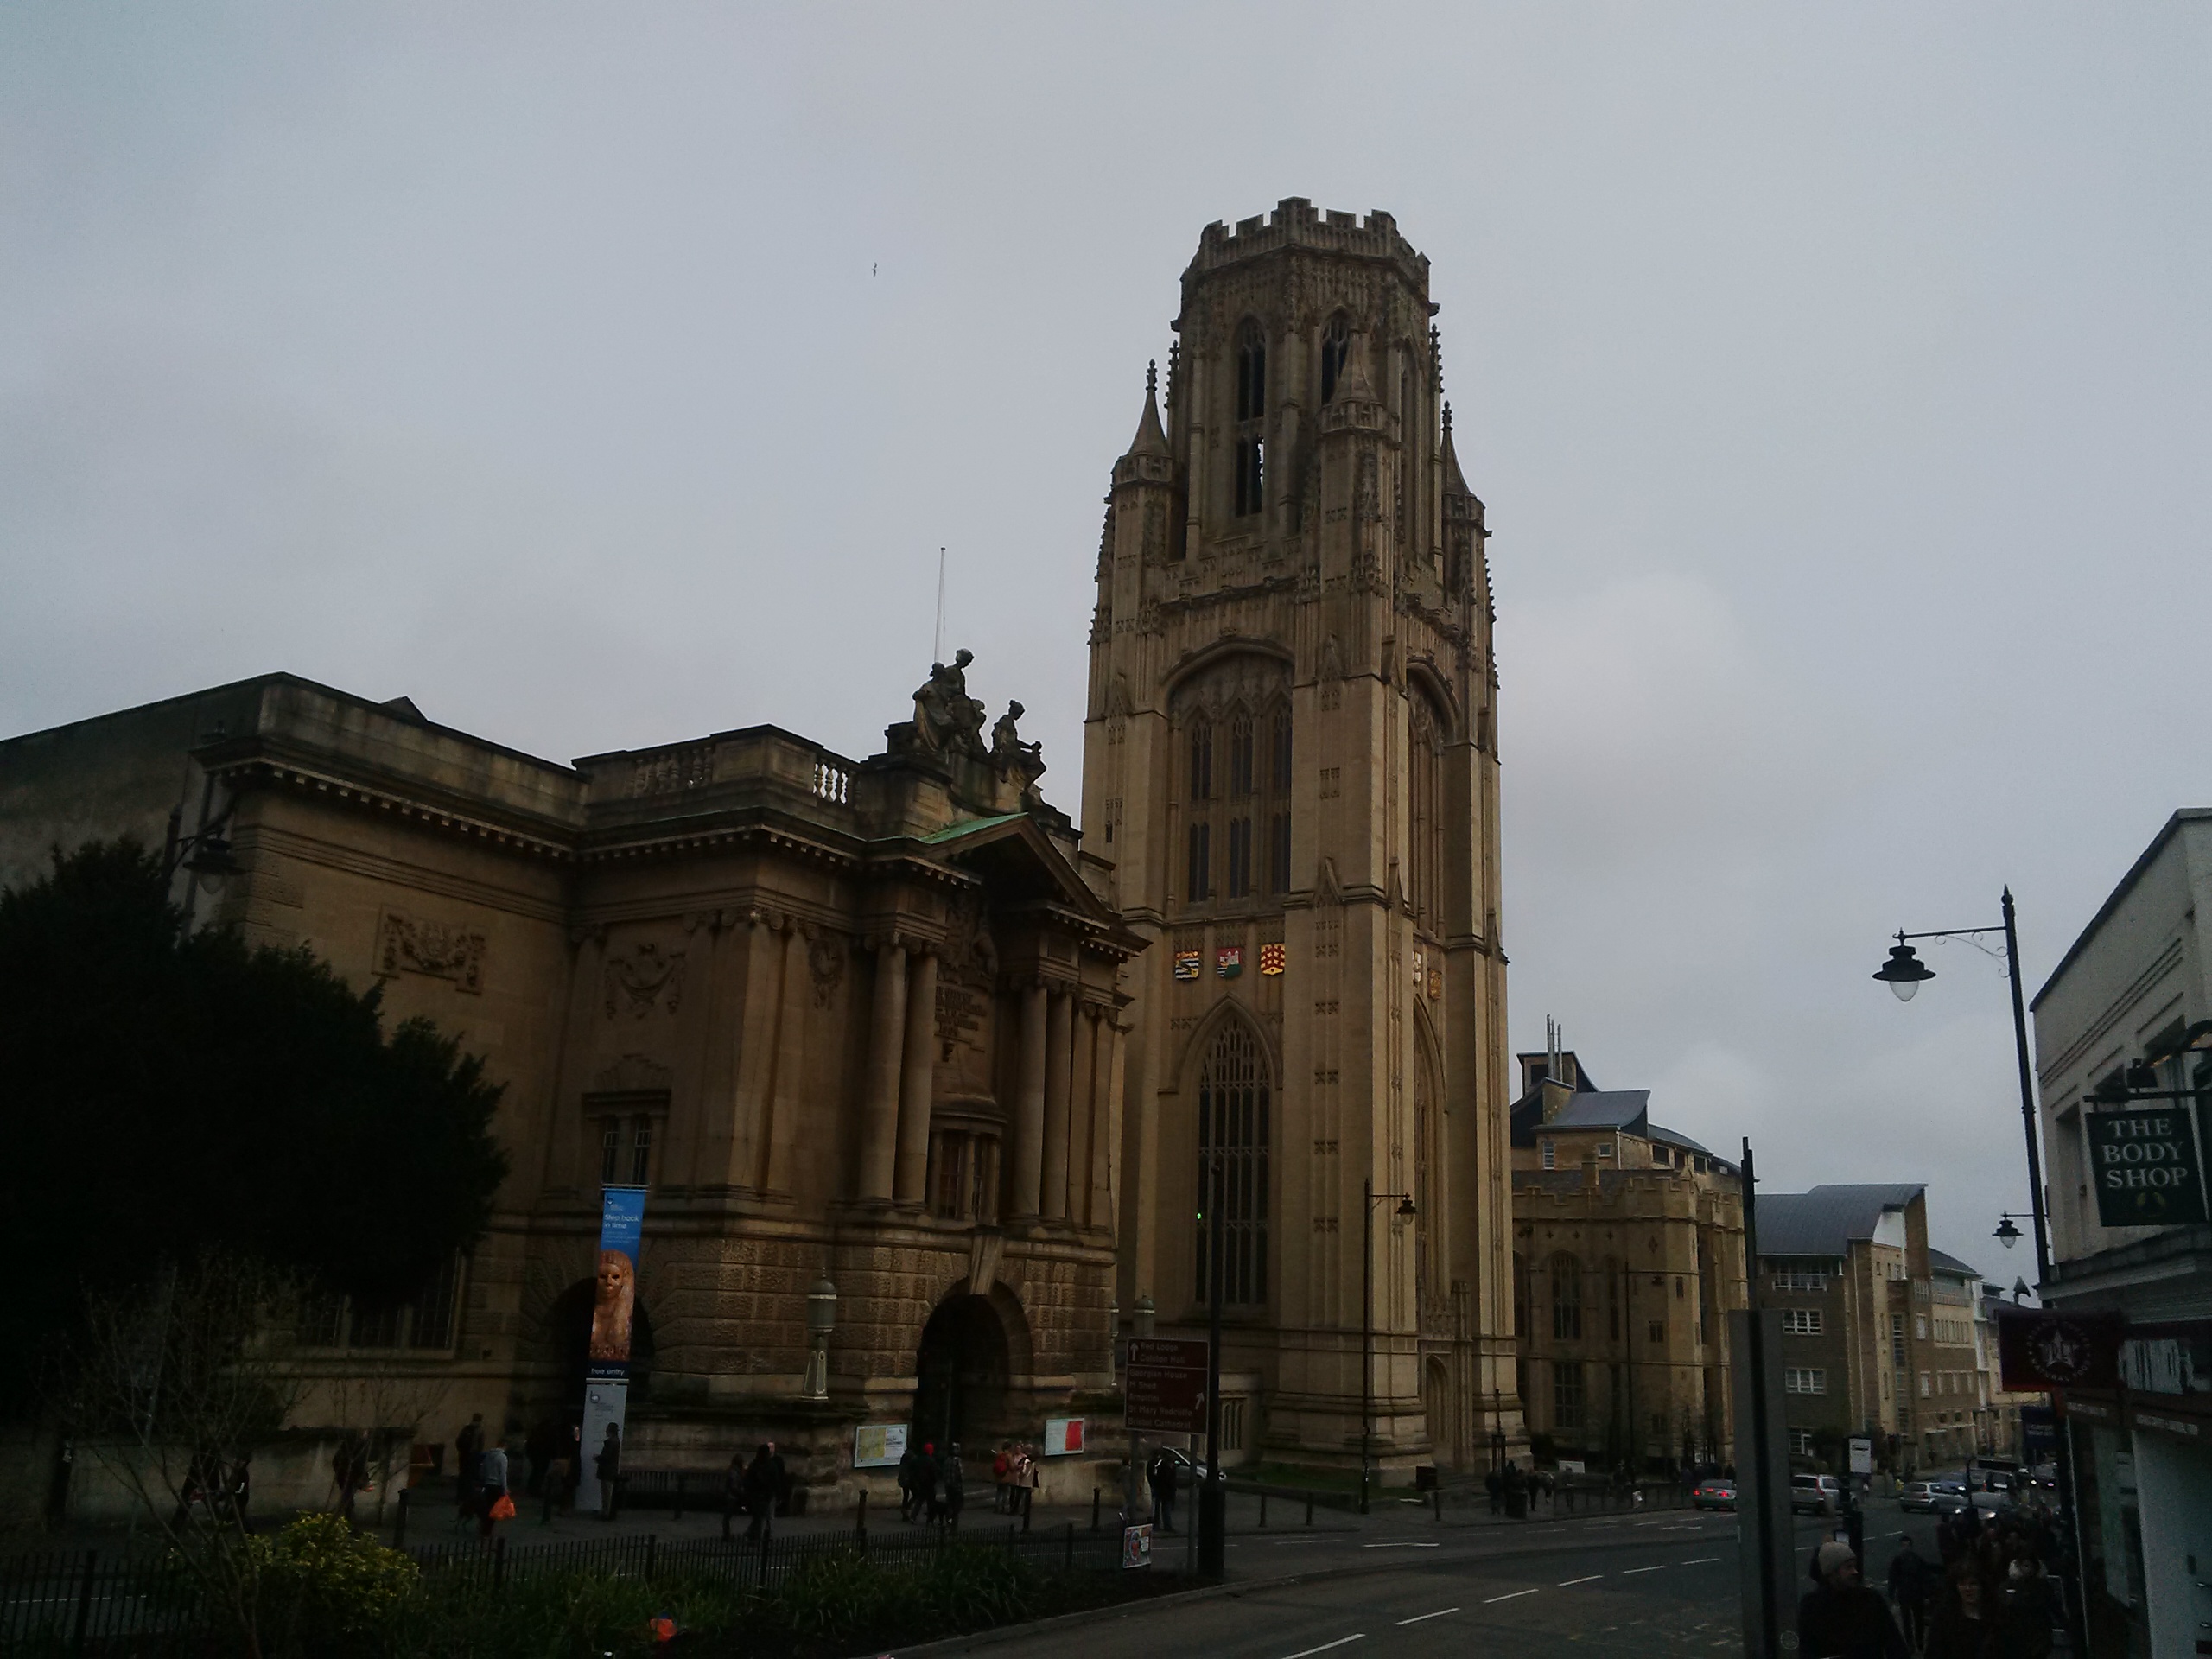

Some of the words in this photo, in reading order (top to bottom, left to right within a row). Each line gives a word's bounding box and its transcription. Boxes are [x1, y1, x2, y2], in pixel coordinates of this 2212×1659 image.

[2107, 1118, 2172, 1137] THE
[2101, 1141, 2183, 1164] BODY
[2107, 1167, 2188, 1188] SHOP
[605, 1213, 620, 1222] Step
[1140, 1341, 1154, 1351] Red
[1156, 1343, 1179, 1352] Lodge
[1170, 1356, 1185, 1364] Hall
[607, 1368, 625, 1376] entry
[1128, 1368, 1162, 1378] Georgian
[1164, 1370, 1188, 1379] House
[1138, 1381, 1157, 1389] Shed
[1128, 1405, 1137, 1414] St
[1139, 1405, 1157, 1416] Mary
[1159, 1407, 1193, 1417] Redcliffe
[1154, 1419, 1191, 1429] Cathedral
